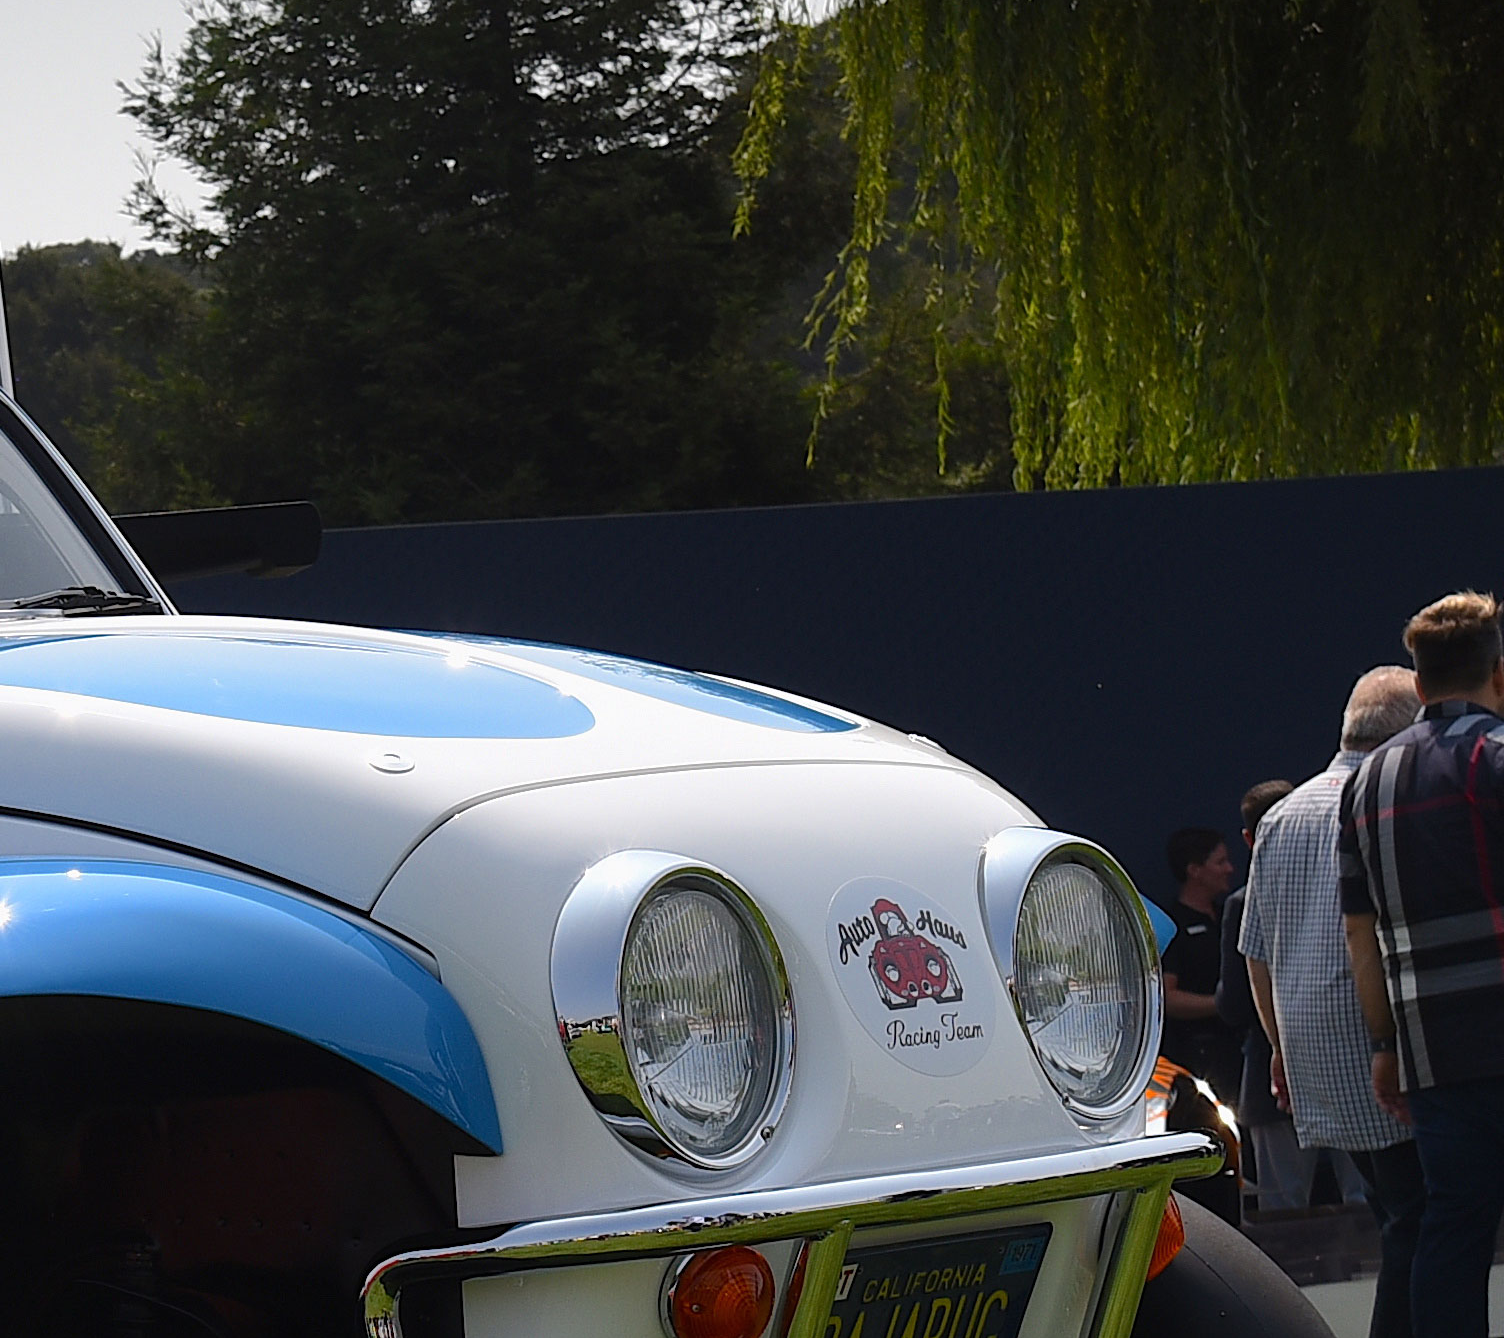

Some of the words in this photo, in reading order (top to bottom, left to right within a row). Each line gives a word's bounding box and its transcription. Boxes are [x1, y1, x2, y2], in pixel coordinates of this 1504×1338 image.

[837, 915, 876, 965] Auto
[915, 909, 968, 950] Haus
[886, 1019, 941, 1050] Racing
[940, 1011, 984, 1041] Team
[862, 1263, 988, 1304] CALIFORNIA
